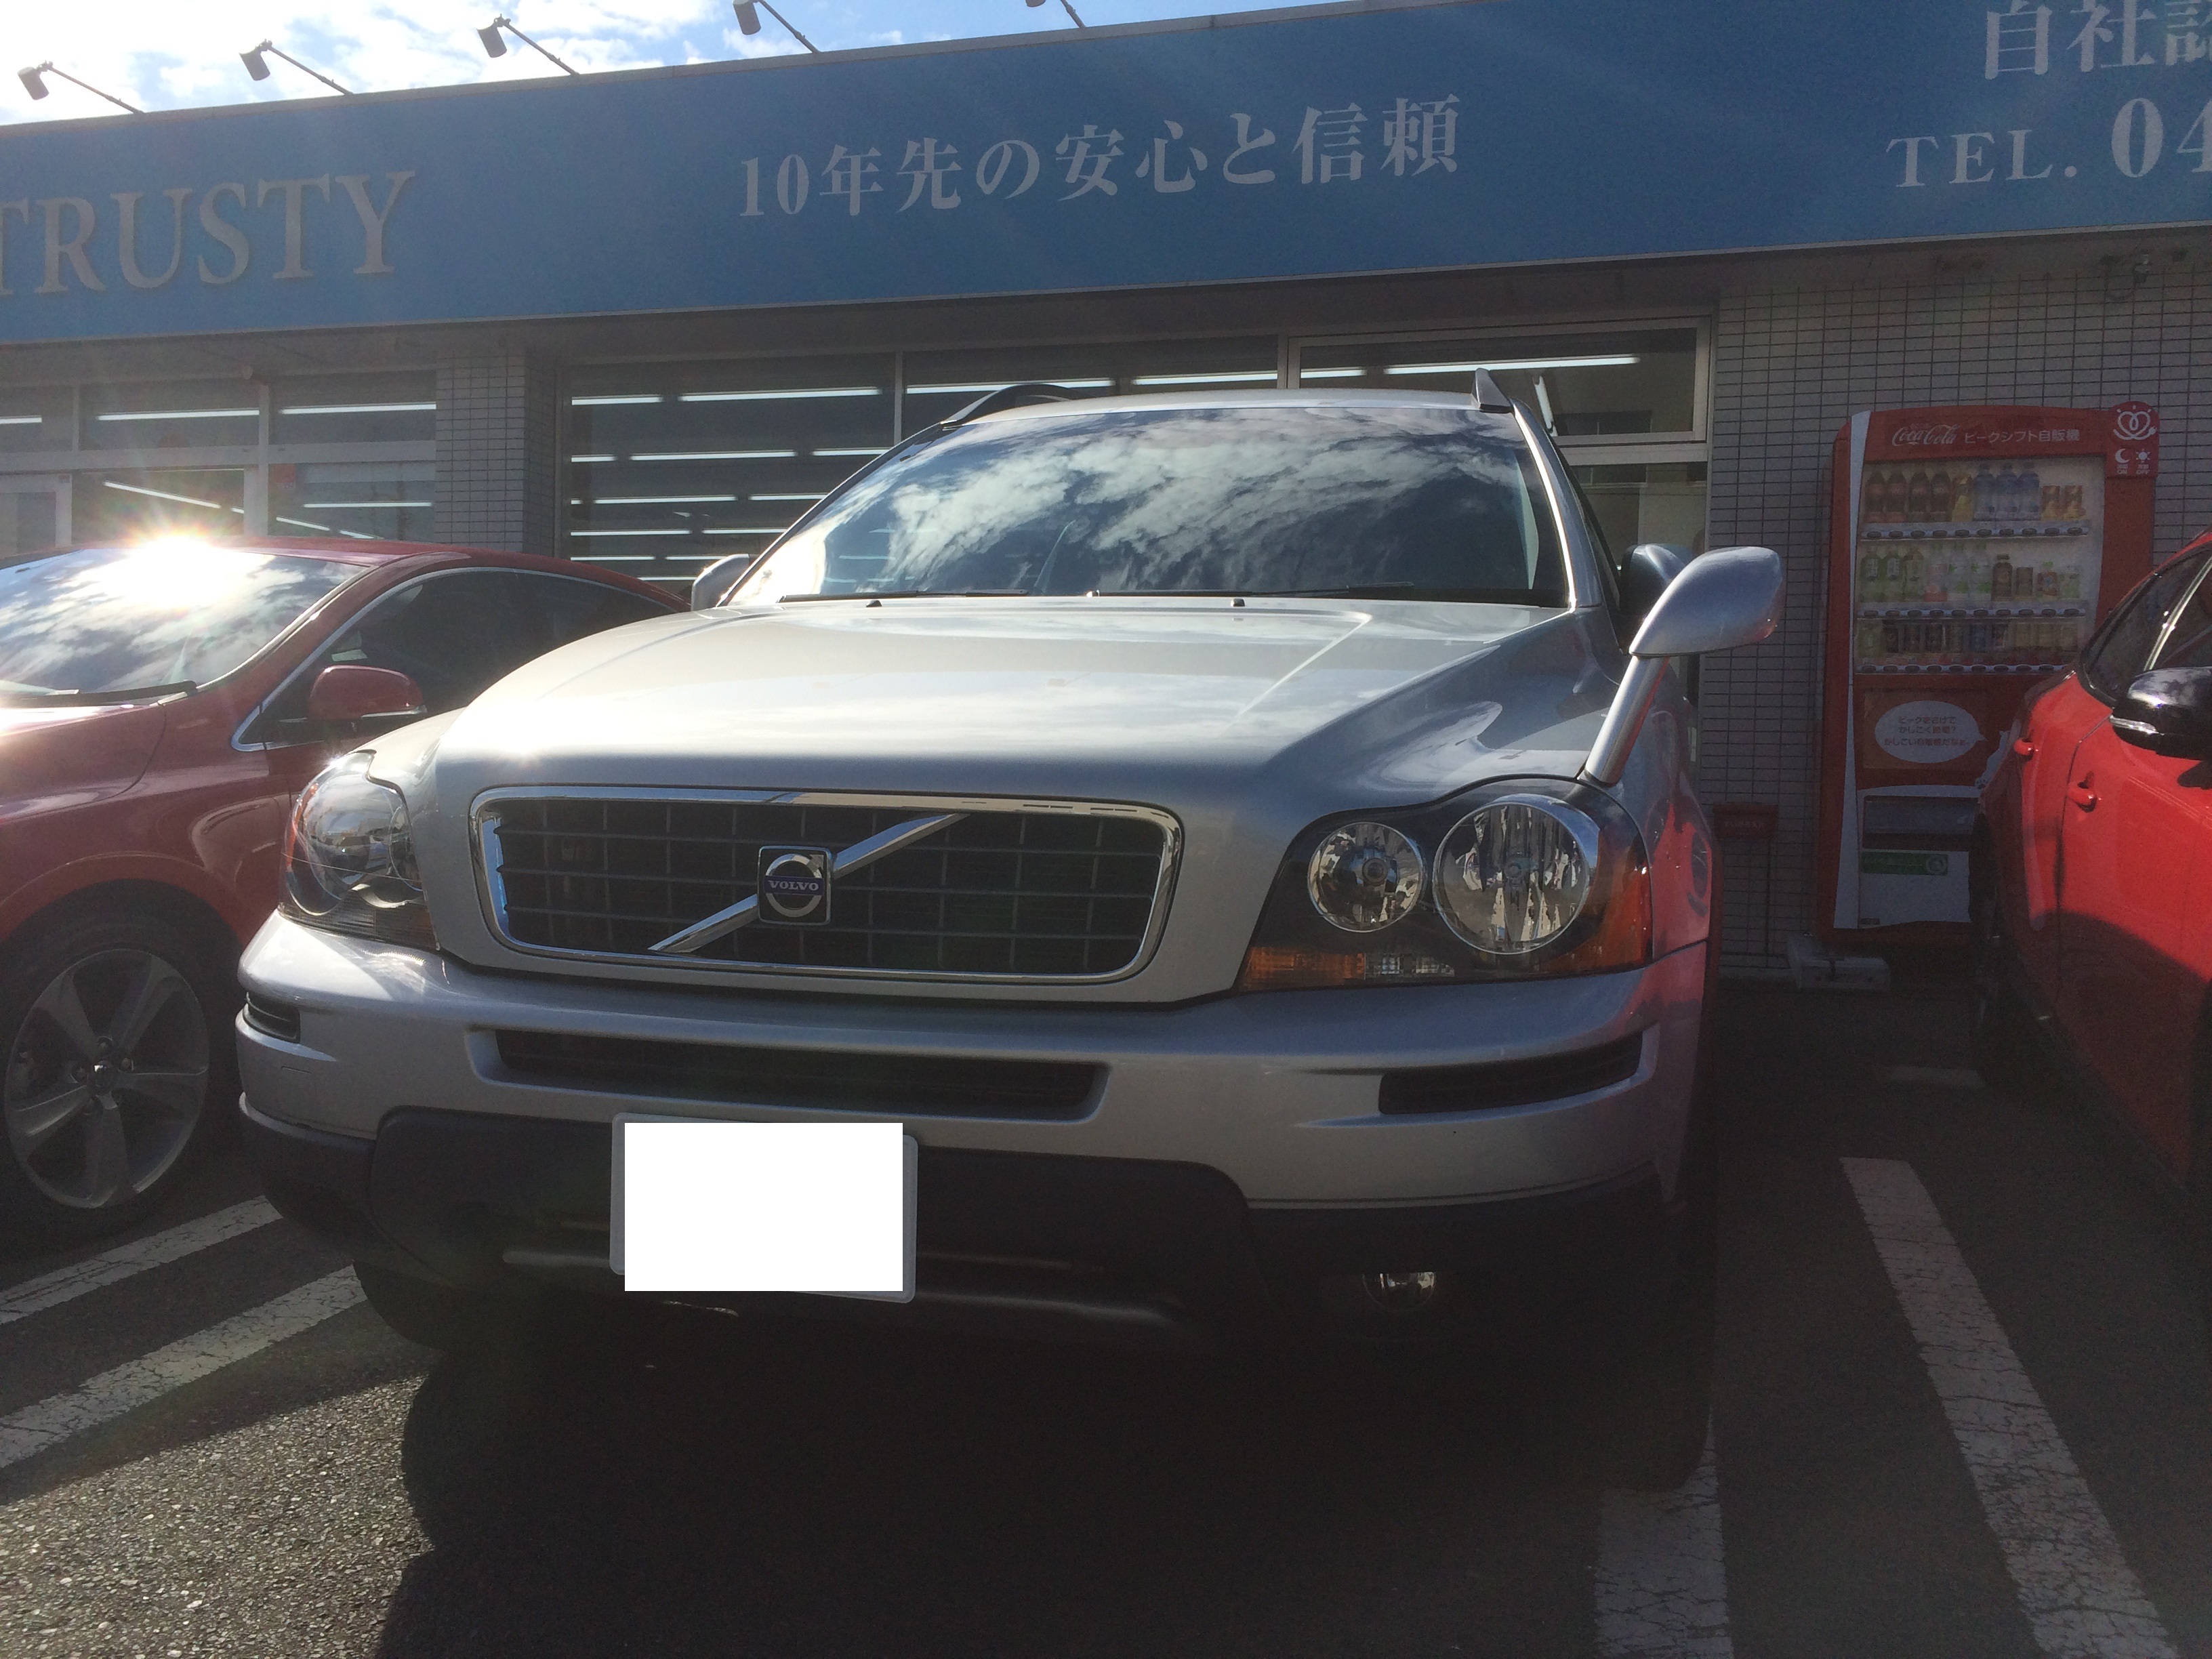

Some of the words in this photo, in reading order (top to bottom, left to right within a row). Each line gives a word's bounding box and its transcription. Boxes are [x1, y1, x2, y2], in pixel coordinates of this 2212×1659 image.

[740, 93, 1461, 218] 10年先の安心と信頼
[1885, 129, 2077, 188] TEL.
[768, 880, 819, 891] VOLVO
